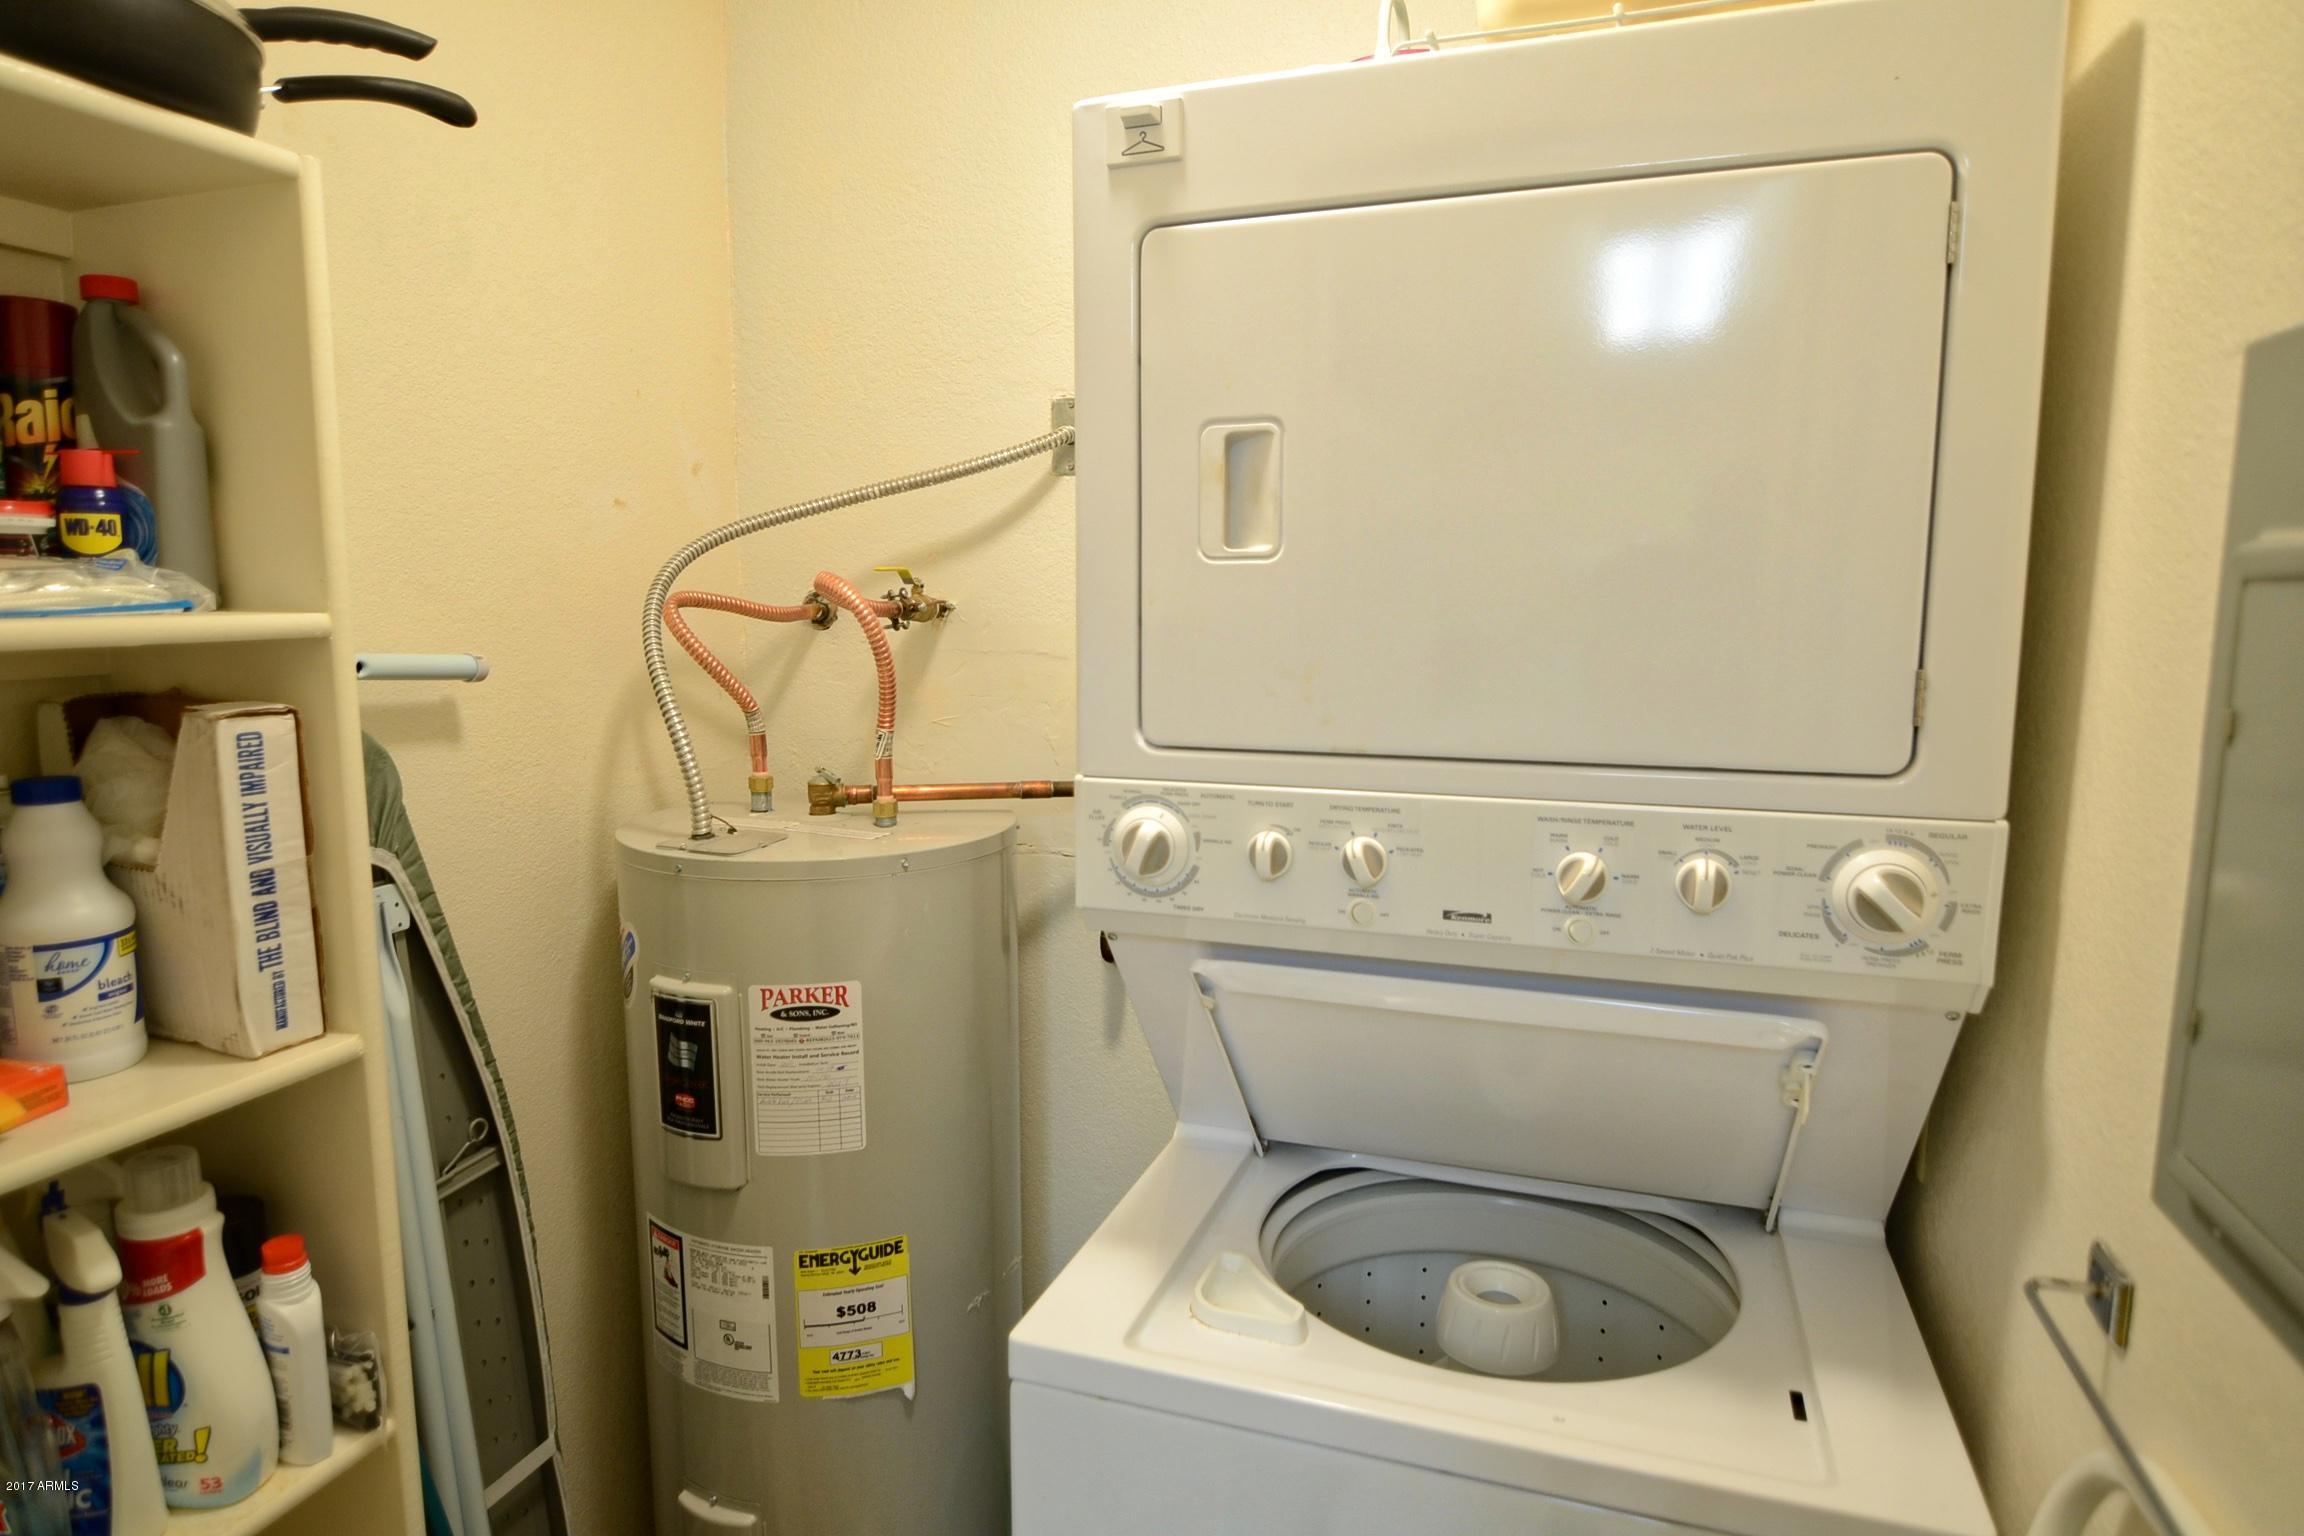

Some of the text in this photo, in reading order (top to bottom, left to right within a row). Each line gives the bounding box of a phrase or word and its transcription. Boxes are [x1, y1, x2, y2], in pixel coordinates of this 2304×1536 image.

[64, 517, 118, 537] WD-40
[236, 731, 266, 797] IMPAIRED
[1329, 804, 1401, 815] DRYING TEMPERATURE
[1583, 818, 1634, 827] TEMPERATURE
[1681, 823, 1733, 833] WATER LEVEL
[242, 802, 273, 865] VISUALLY
[1928, 832, 1968, 841] REGULAR
[249, 867, 277, 896] AND
[253, 900, 281, 943] BLIND
[1778, 930, 1820, 940] DELICATES
[44, 952, 91, 972] home
[257, 943, 283, 973] THE
[1936, 958, 1963, 966] PRESS
[760, 985, 849, 1012] PARKER
[780, 1008, 830, 1018] & SONS, INC.
[798, 1239, 904, 1276] ENERGYGUIDE
[142, 1273, 169, 1287] MORE
[142, 1281, 173, 1297] LOADS
[836, 1301, 877, 1318] $508
[832, 1349, 861, 1361] 4773
[200, 1476, 222, 1491] 53
